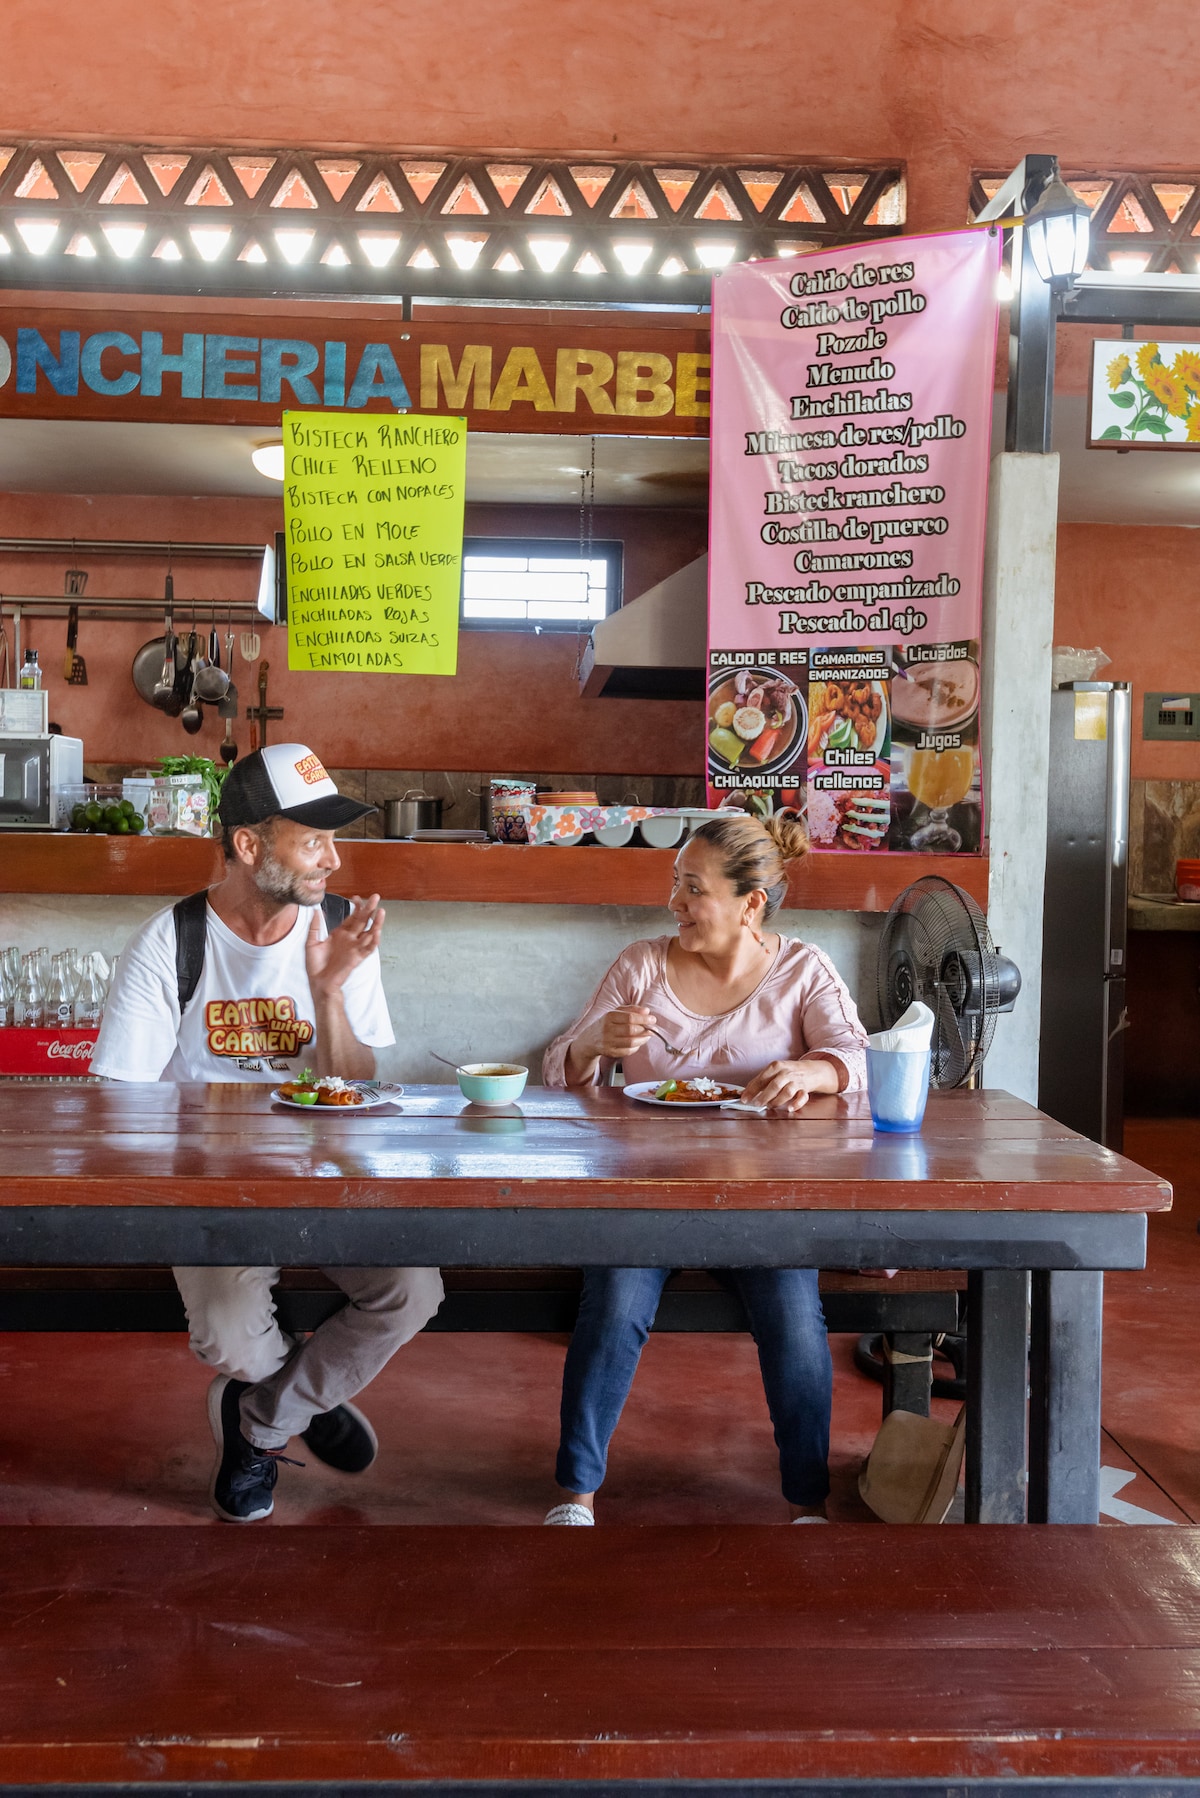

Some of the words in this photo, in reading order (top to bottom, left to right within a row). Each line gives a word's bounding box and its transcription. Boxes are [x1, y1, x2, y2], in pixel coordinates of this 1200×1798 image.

[791, 270, 848, 295] Caldo
[850, 265, 876, 288] de
[880, 262, 914, 281] res
[781, 303, 841, 328] Caldo
[842, 298, 868, 320] de
[871, 290, 926, 322] pollo
[817, 329, 886, 355] Pozole
[0, 328, 412, 408] NCHERIA
[807, 358, 894, 386] Menudo
[791, 389, 911, 418] Enchiladas
[289, 422, 368, 449] BISTECK
[377, 424, 459, 449] RANCHERO
[746, 429, 836, 455] Milanesa
[840, 423, 866, 446] de
[869, 415, 966, 446] res/pollo
[291, 454, 339, 476] CHILE
[352, 454, 437, 477] RELLENO
[779, 460, 837, 483] Tacos
[841, 452, 928, 478] dorados
[287, 485, 358, 508] BISTECK
[367, 489, 391, 504] CON
[396, 484, 455, 500] NOPALES
[765, 488, 843, 514] Bisteck
[845, 483, 945, 507] ranchero
[290, 517, 333, 545] POLLO
[342, 523, 365, 541] EN
[376, 521, 421, 541] MOLE
[761, 519, 841, 544] Costilla
[843, 517, 868, 538] de
[871, 517, 948, 542] puerco
[291, 552, 333, 575] POLLO
[342, 553, 366, 569] EN
[374, 551, 416, 568] SALSA
[420, 551, 459, 566] VERDE
[795, 550, 912, 573] Camarones
[291, 584, 371, 604] ENCHILADAS
[376, 583, 432, 601] VERDES
[746, 581, 832, 604] Pescado
[834, 573, 961, 605] empanizado
[292, 608, 372, 626] ENCHILADAS
[384, 606, 430, 624] ROJAS
[779, 611, 865, 633] Pescado
[869, 609, 890, 629] al
[893, 607, 927, 635] ajo
[295, 630, 382, 648] ENCHILADAS
[389, 631, 439, 647] SUIZAS
[309, 652, 403, 668] ENMOLADAS
[710, 652, 755, 666] CALDO
[758, 652, 776, 665] DE
[779, 651, 808, 665] RES
[813, 652, 885, 666] CAMARONES
[908, 645, 968, 662] Licuados
[808, 668, 889, 681] EMPANIZADOS
[916, 732, 961, 751] Jugos
[824, 748, 875, 765] Chiles
[714, 774, 800, 789] CHILAQUILES
[814, 773, 883, 789] rellenos
[208, 998, 292, 1027] EATING
[209, 1029, 296, 1053] CARMEN
[270, 1020, 310, 1040] with
[47, 1040, 97, 1060] Coca-Col
[230, 1056, 260, 1070] Food
